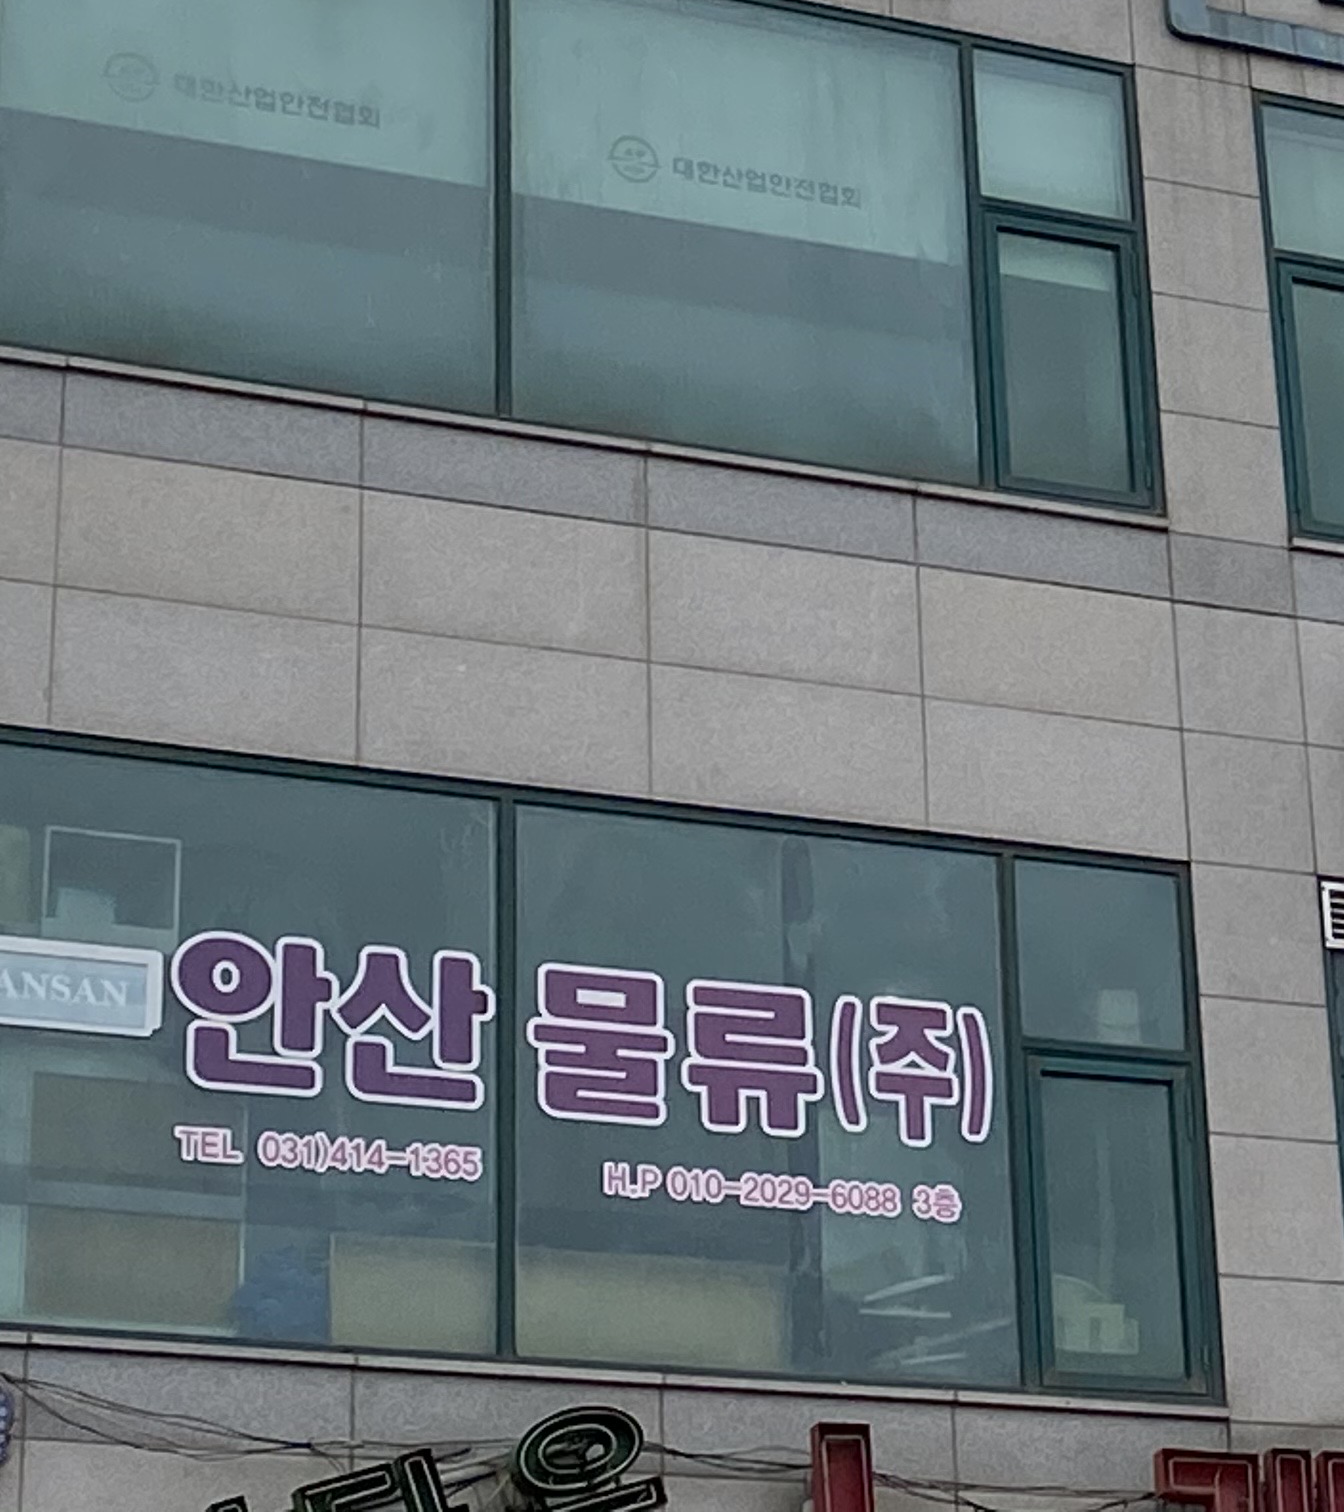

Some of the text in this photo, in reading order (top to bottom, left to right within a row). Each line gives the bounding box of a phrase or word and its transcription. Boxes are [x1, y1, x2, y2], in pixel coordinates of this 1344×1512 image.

[672, 156, 862, 210] 대한산업안전협회
[172, 930, 994, 1147] 안산 물류(주)
[174, 1126, 483, 1181] TEL 031)414-1365
[603, 1162, 962, 1222] H.P 010-2029-6088 3층
